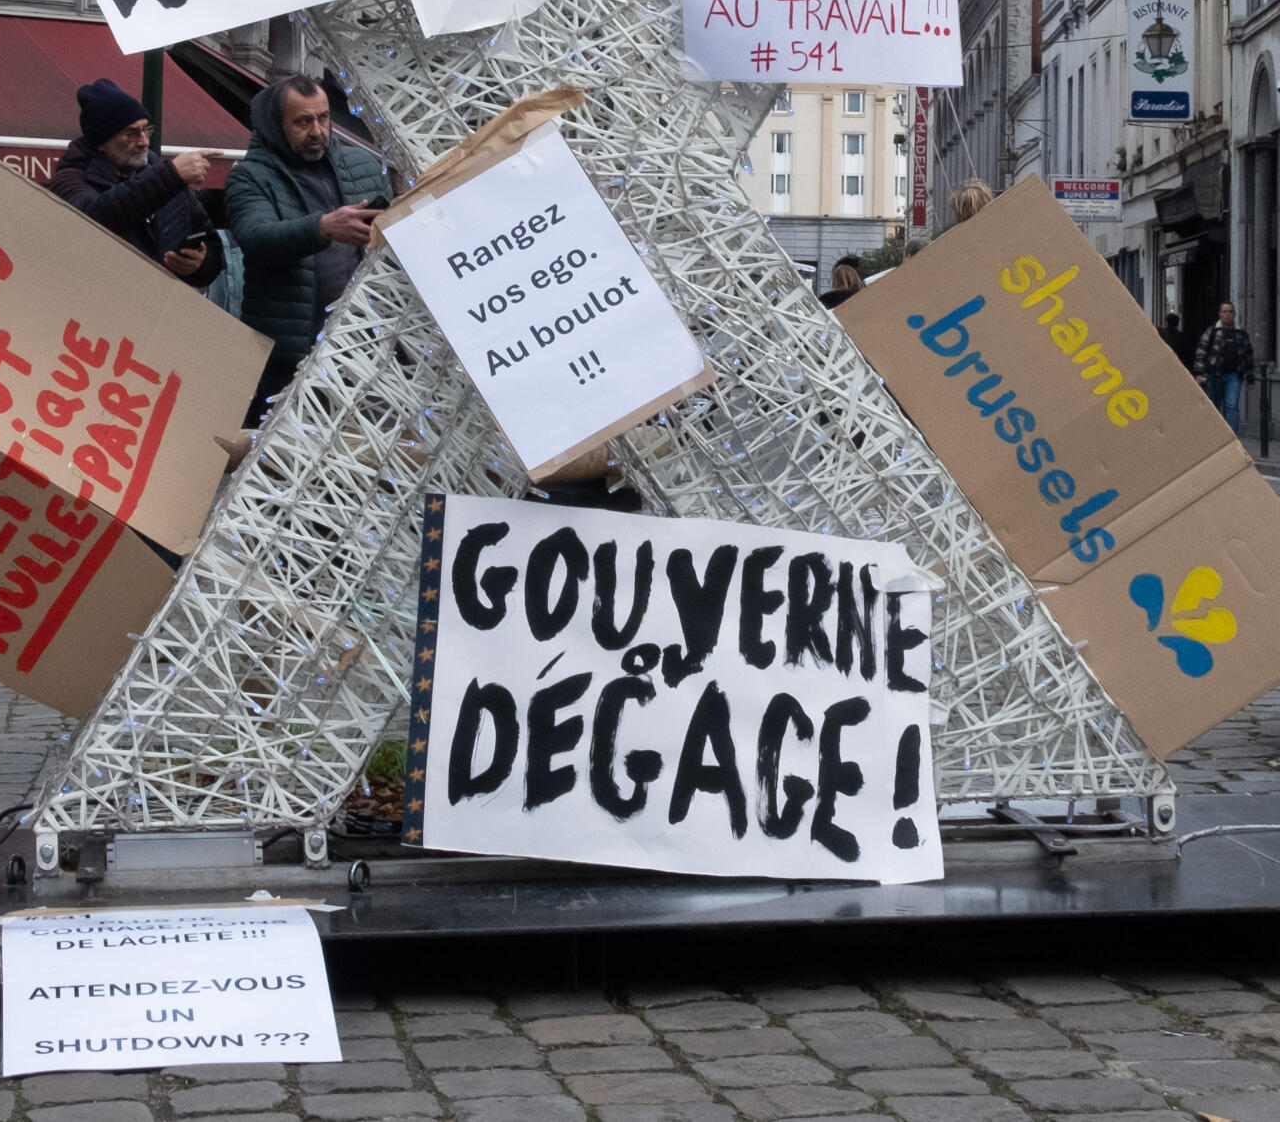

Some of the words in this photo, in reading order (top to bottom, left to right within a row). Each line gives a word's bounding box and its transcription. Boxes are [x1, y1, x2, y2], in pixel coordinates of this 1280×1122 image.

[1132, 1, 1190, 20] RISTORANTE
[1134, 98, 1186, 111] Paradise
[3, 155, 59, 179] SIN
[1064, 182, 1111, 191] WELCOME
[446, 203, 565, 279] Rangez
[467, 283, 526, 324] vos
[531, 247, 598, 289] ego.
[486, 341, 530, 377] Au
[529, 276, 639, 348] boulot
[999, 255, 1150, 428] shame
[569, 350, 606, 385] !!!
[906, 294, 1120, 564] .brussels
[452, 522, 929, 693] GOUVERNE
[620, 642, 713, 688] OU
[56, 939, 93, 950] DE
[28, 975, 306, 1000] ATTENDEZ-VOUS
[145, 1008, 194, 1023] UN
[35, 1033, 244, 1054] SHUTDOWN
[255, 1032, 310, 1046] ???
